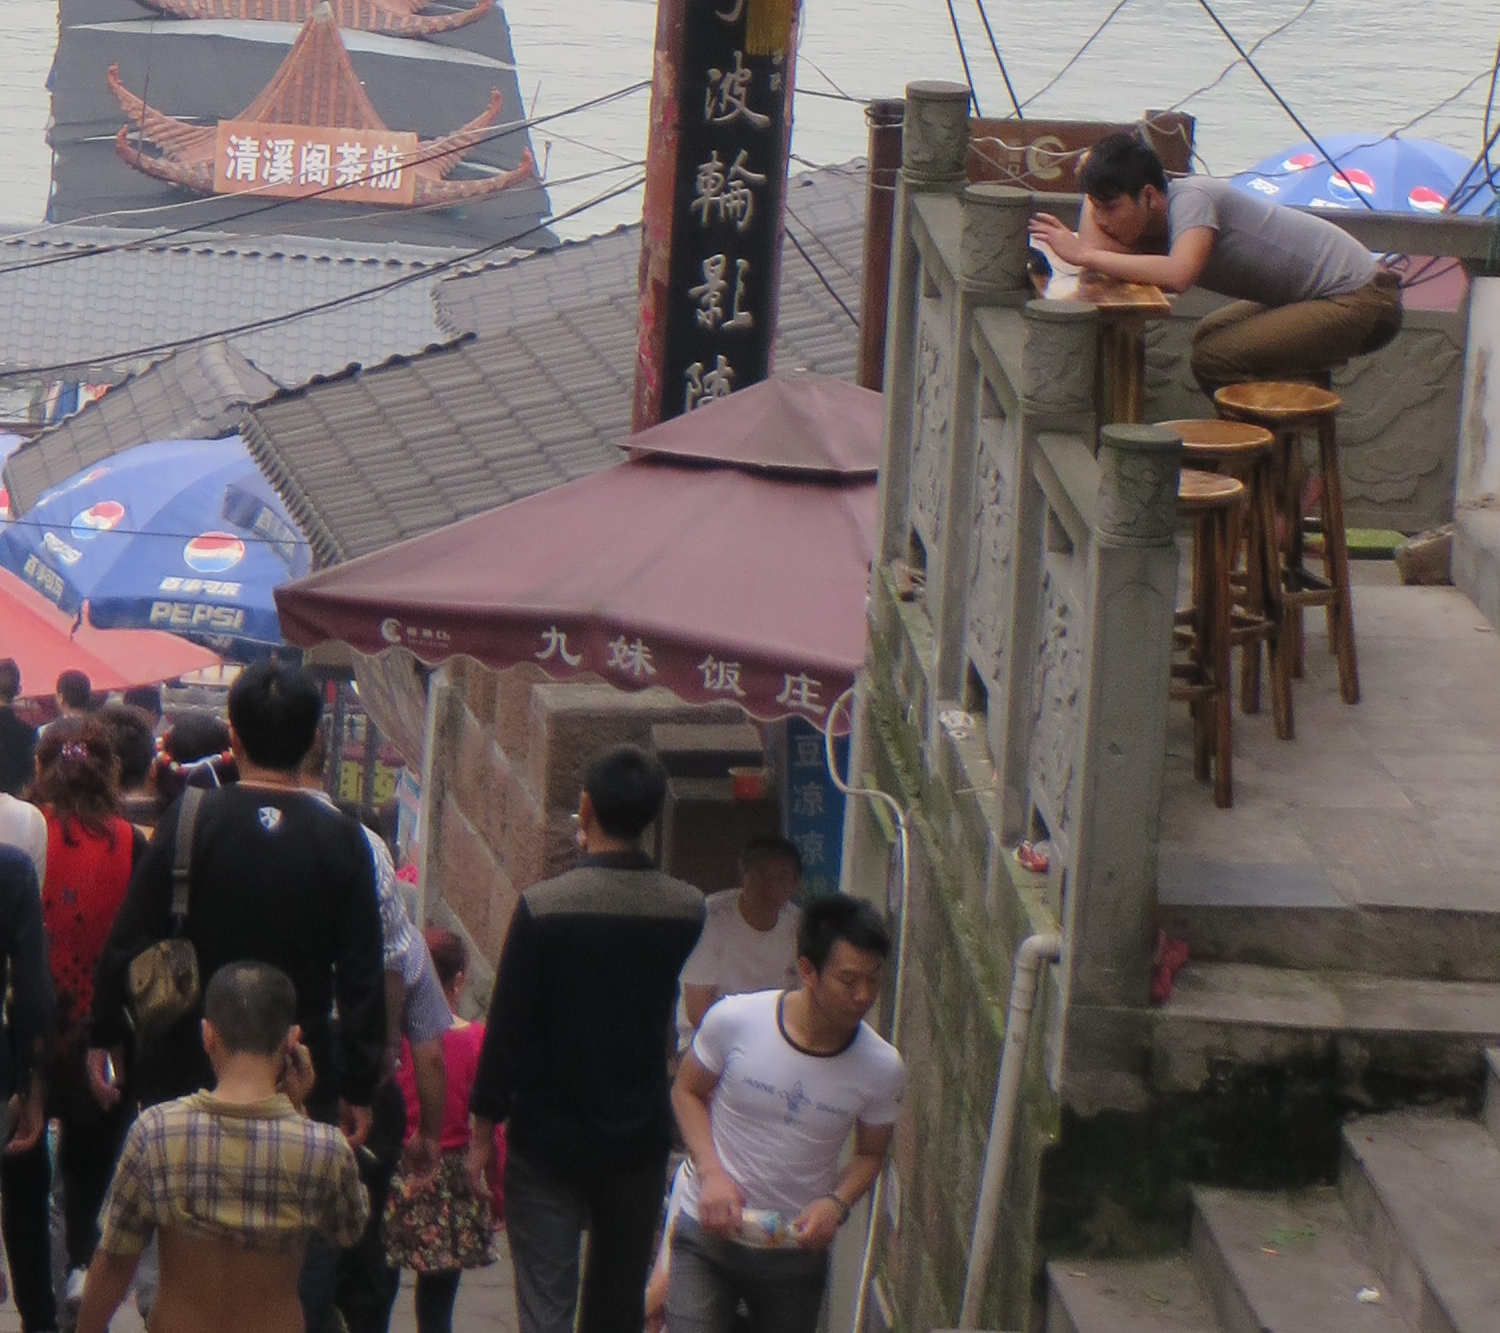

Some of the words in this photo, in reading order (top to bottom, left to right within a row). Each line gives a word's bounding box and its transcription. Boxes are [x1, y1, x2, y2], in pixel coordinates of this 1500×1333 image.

[225, 134, 404, 189] 清溪阁茶舫
[150, 600, 246, 630] PEPSI
[534, 624, 827, 714] 九妹饭庄
